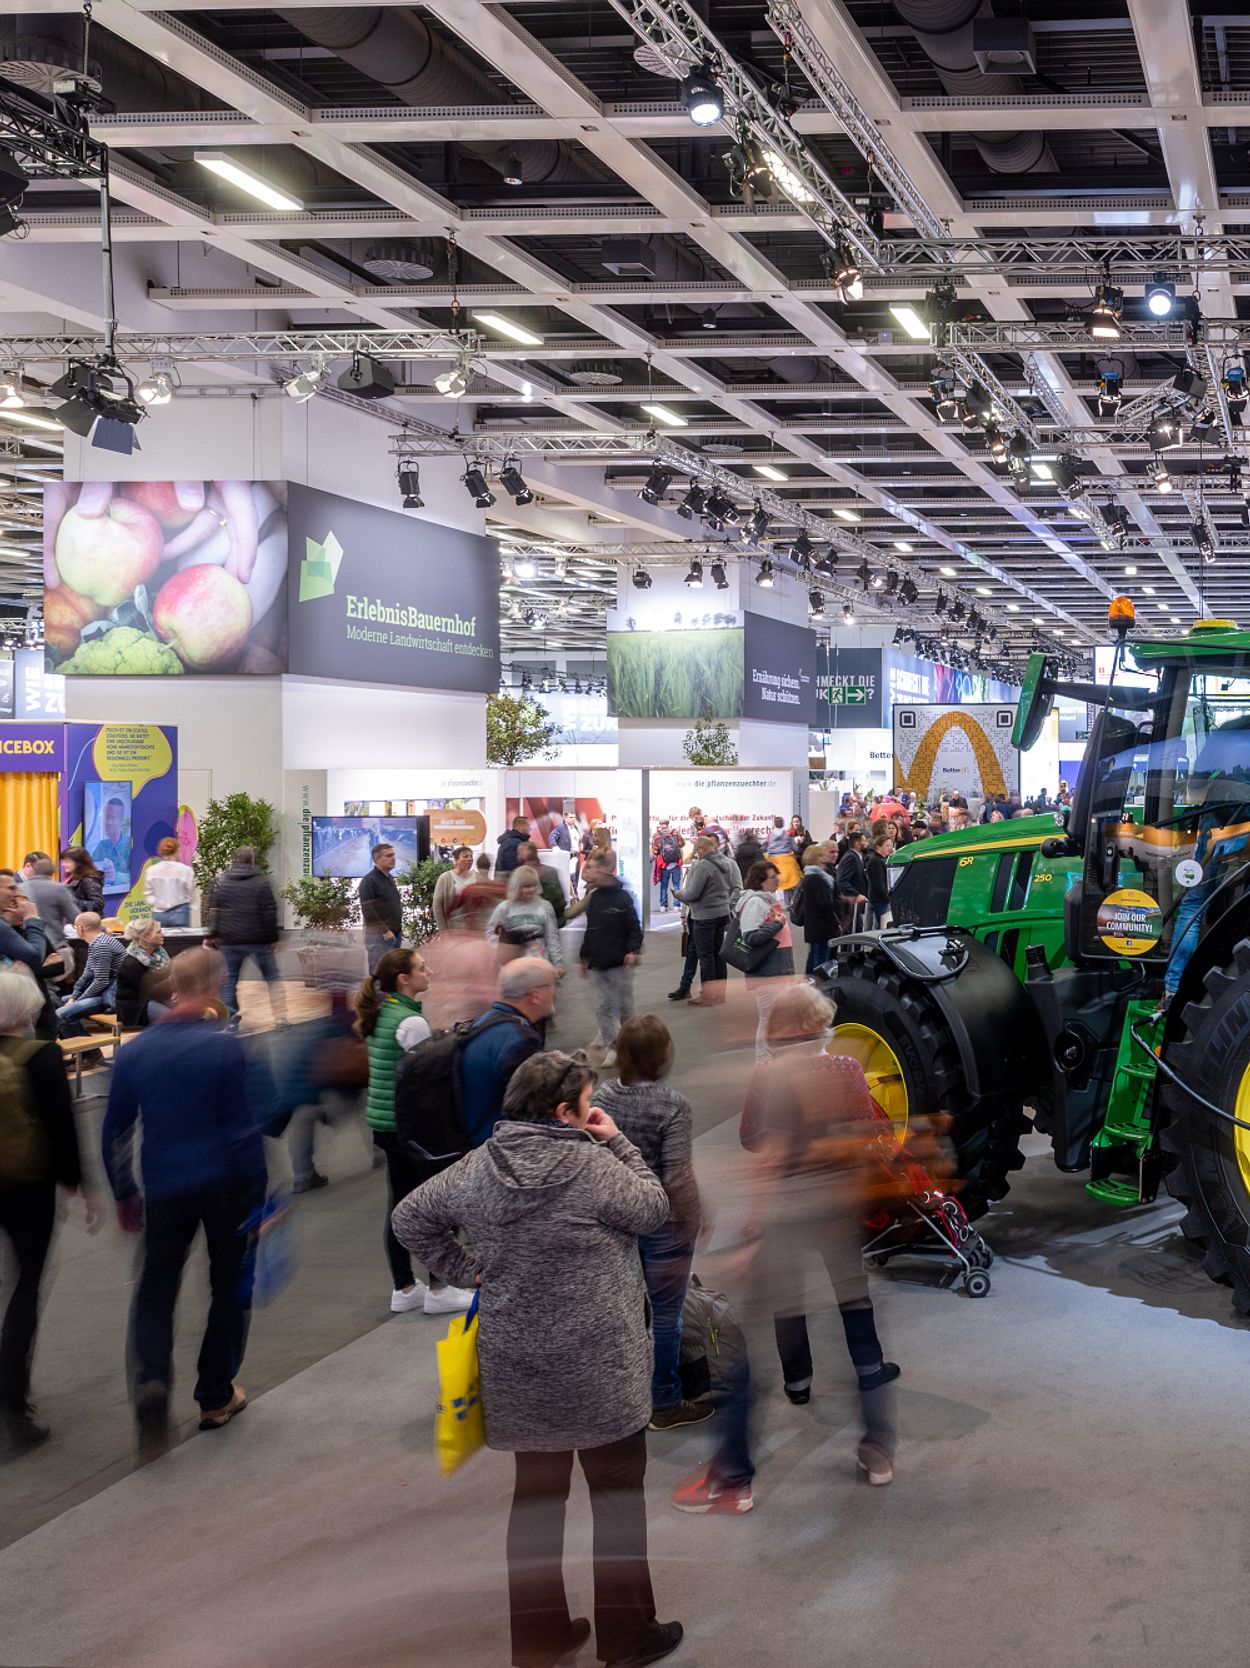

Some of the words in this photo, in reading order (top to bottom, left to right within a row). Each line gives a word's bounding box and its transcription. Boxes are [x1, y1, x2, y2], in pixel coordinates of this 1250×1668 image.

[346, 594, 477, 637] ErlebnisBauernhof
[346, 624, 388, 644] Moderne
[389, 631, 453, 653] Landwirtschaft
[454, 641, 494, 658] entdecken
[859, 675, 876, 687] DIE
[959, 856, 974, 867] 6R
[1033, 873, 1053, 884] 250
[1114, 912, 1130, 921] JOIN
[1131, 913, 1147, 922] OUR
[1106, 921, 1153, 932] COMMUNITY!
